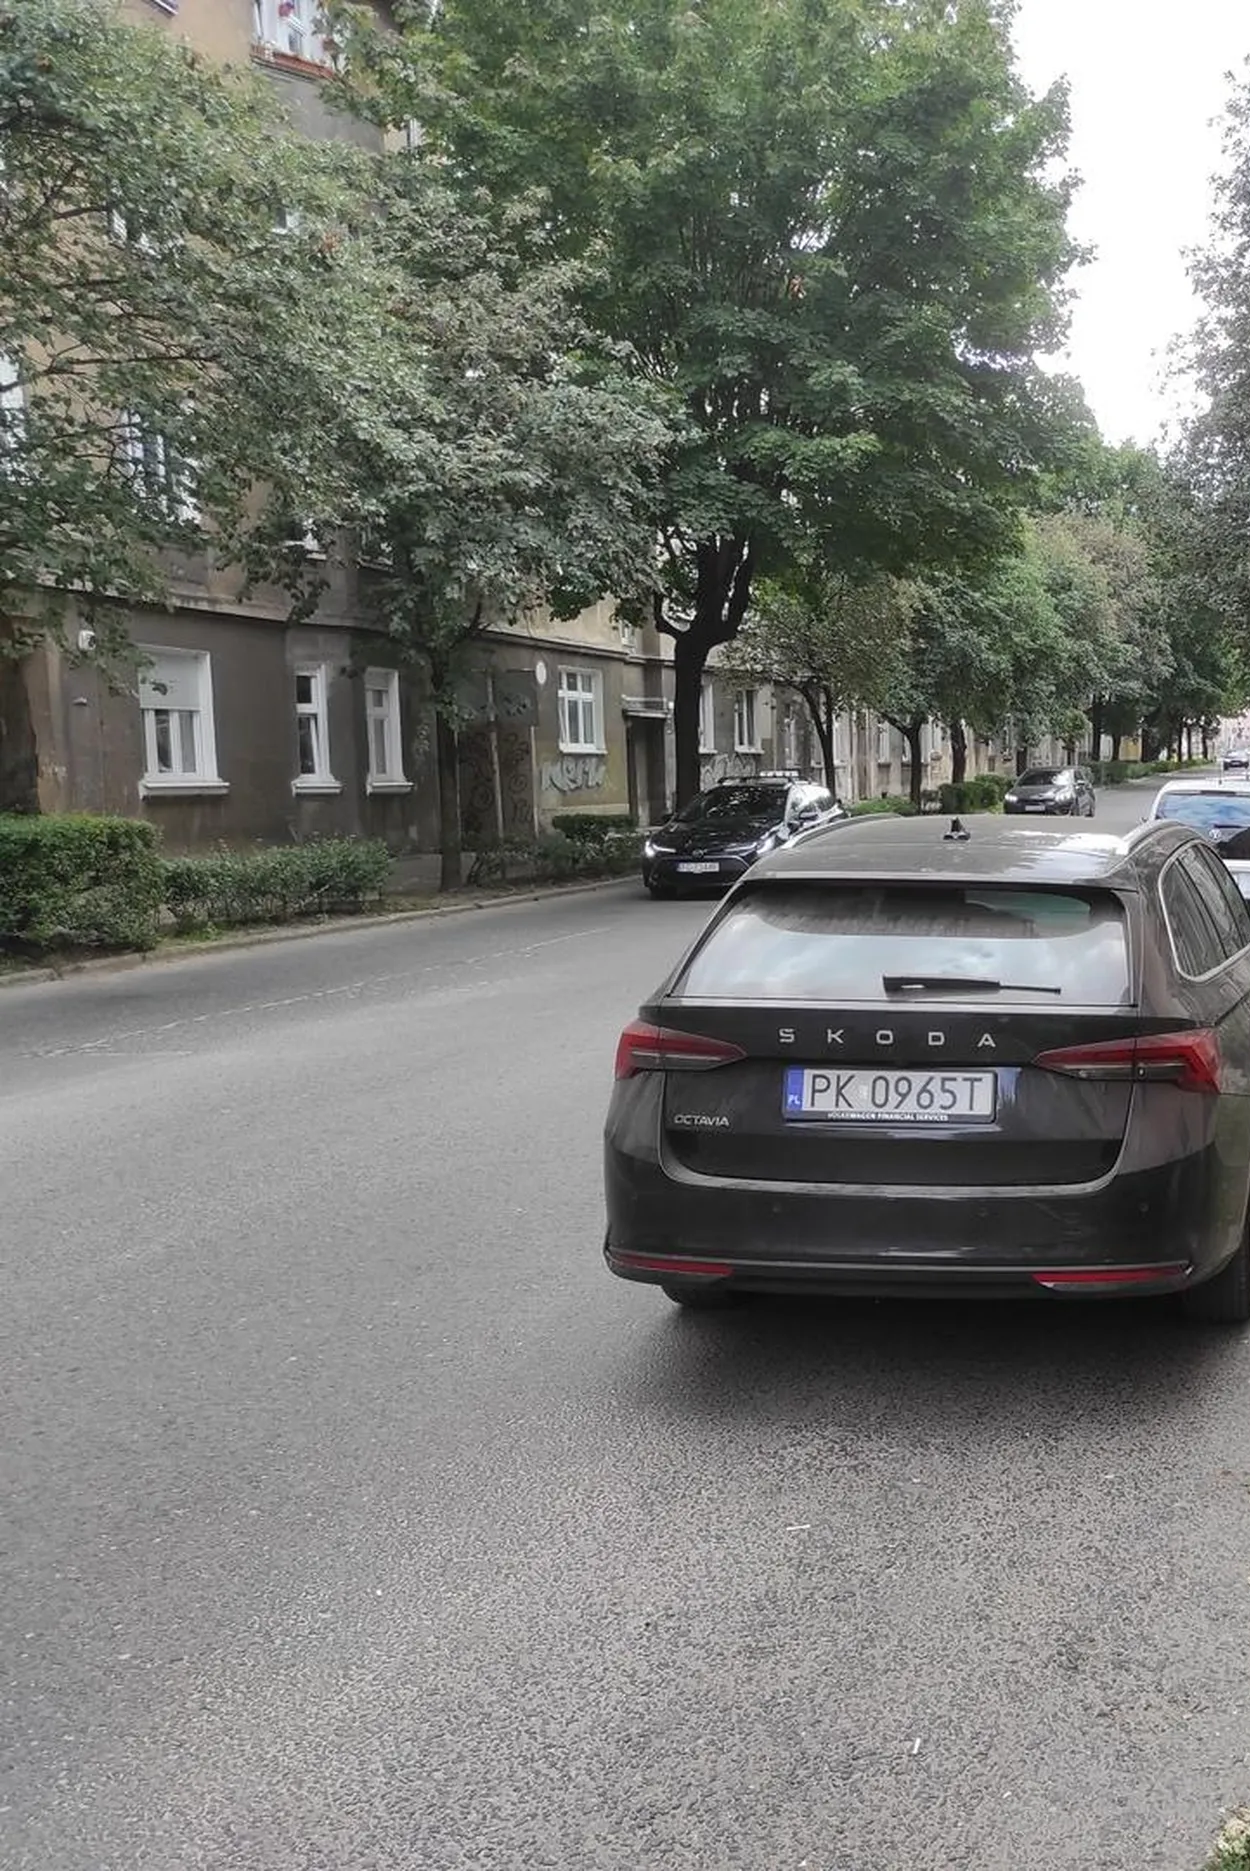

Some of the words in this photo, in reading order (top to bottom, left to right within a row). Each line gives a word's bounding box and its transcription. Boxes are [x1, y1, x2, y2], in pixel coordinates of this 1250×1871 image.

[810, 1073, 856, 1109] PK
[870, 1074, 983, 1111] 0965T
[674, 1114, 730, 1126] OCTAVIA
